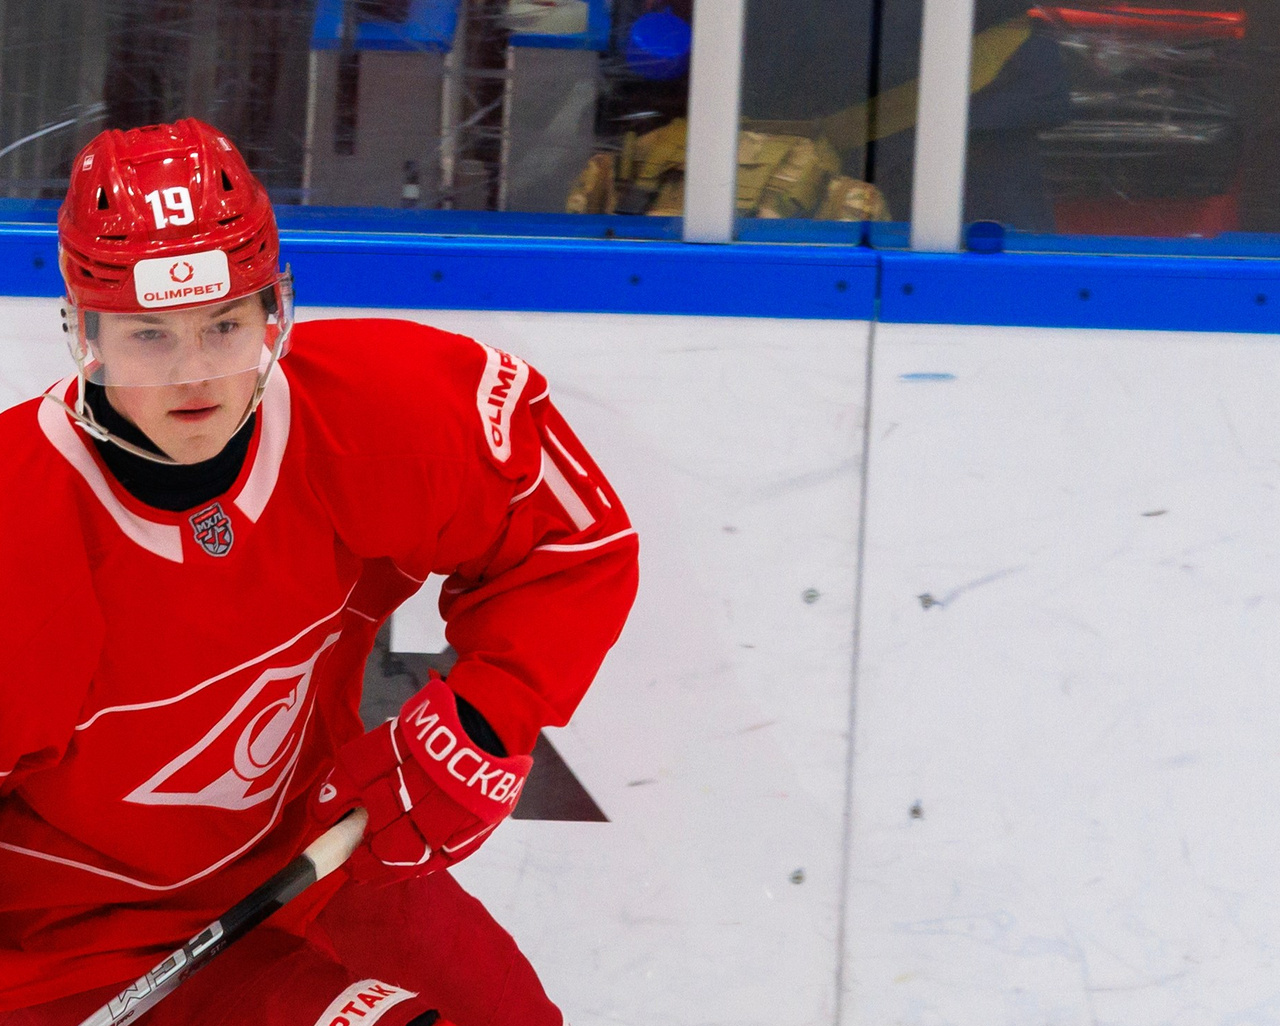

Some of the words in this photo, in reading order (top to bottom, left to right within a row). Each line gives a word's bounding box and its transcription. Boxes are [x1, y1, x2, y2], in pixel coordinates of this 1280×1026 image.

[144, 185, 195, 230] 19
[143, 282, 224, 302] OLIMPBET
[487, 350, 518, 448] OLIMP
[405, 699, 525, 806] МОСКВА
[106, 920, 224, 1021] CCM
